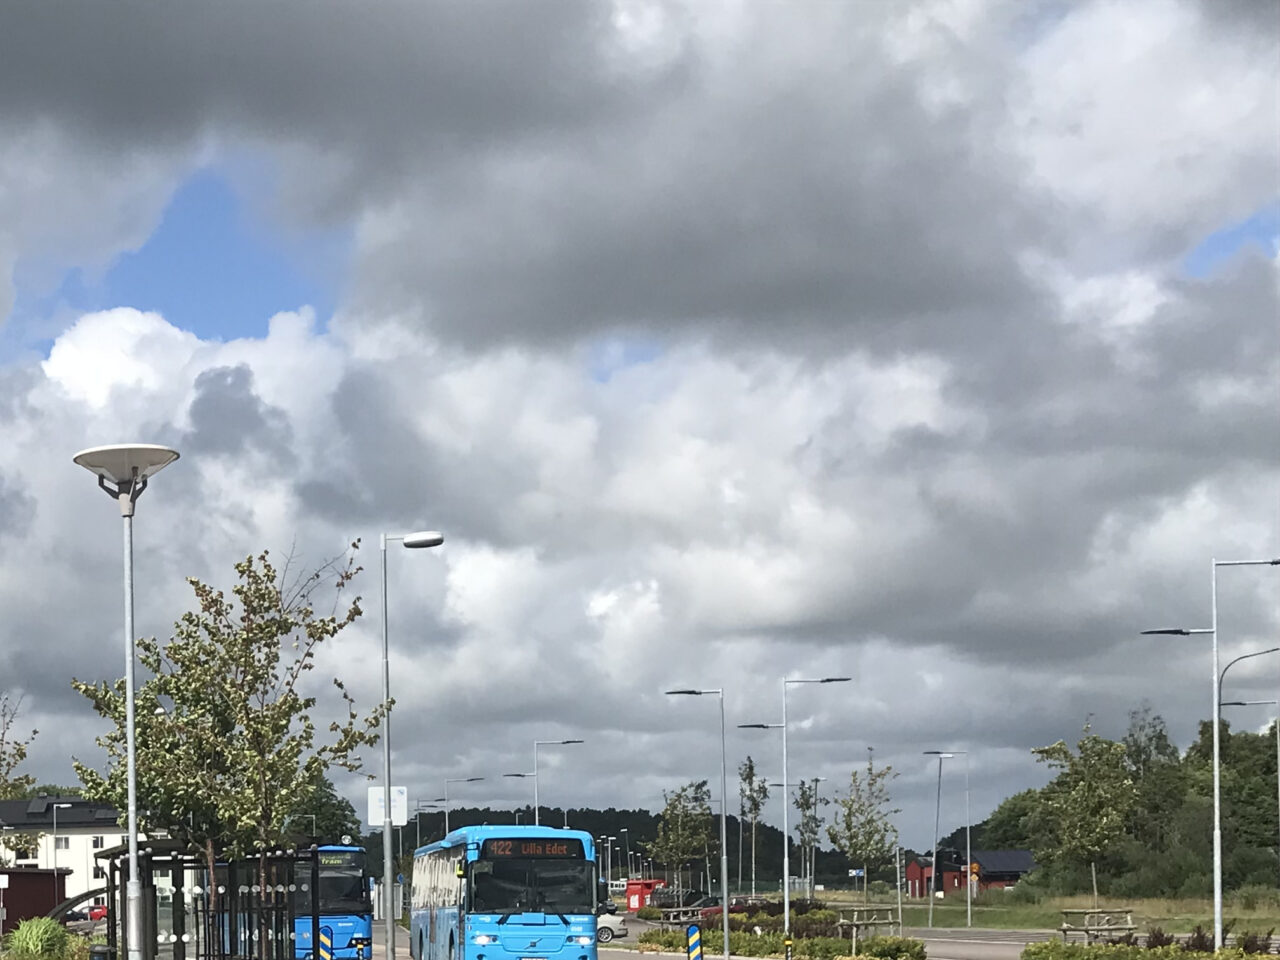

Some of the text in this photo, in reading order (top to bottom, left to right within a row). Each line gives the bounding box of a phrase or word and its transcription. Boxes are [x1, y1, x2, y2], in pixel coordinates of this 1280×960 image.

[490, 840, 567, 855] 422 Lilla Edet
